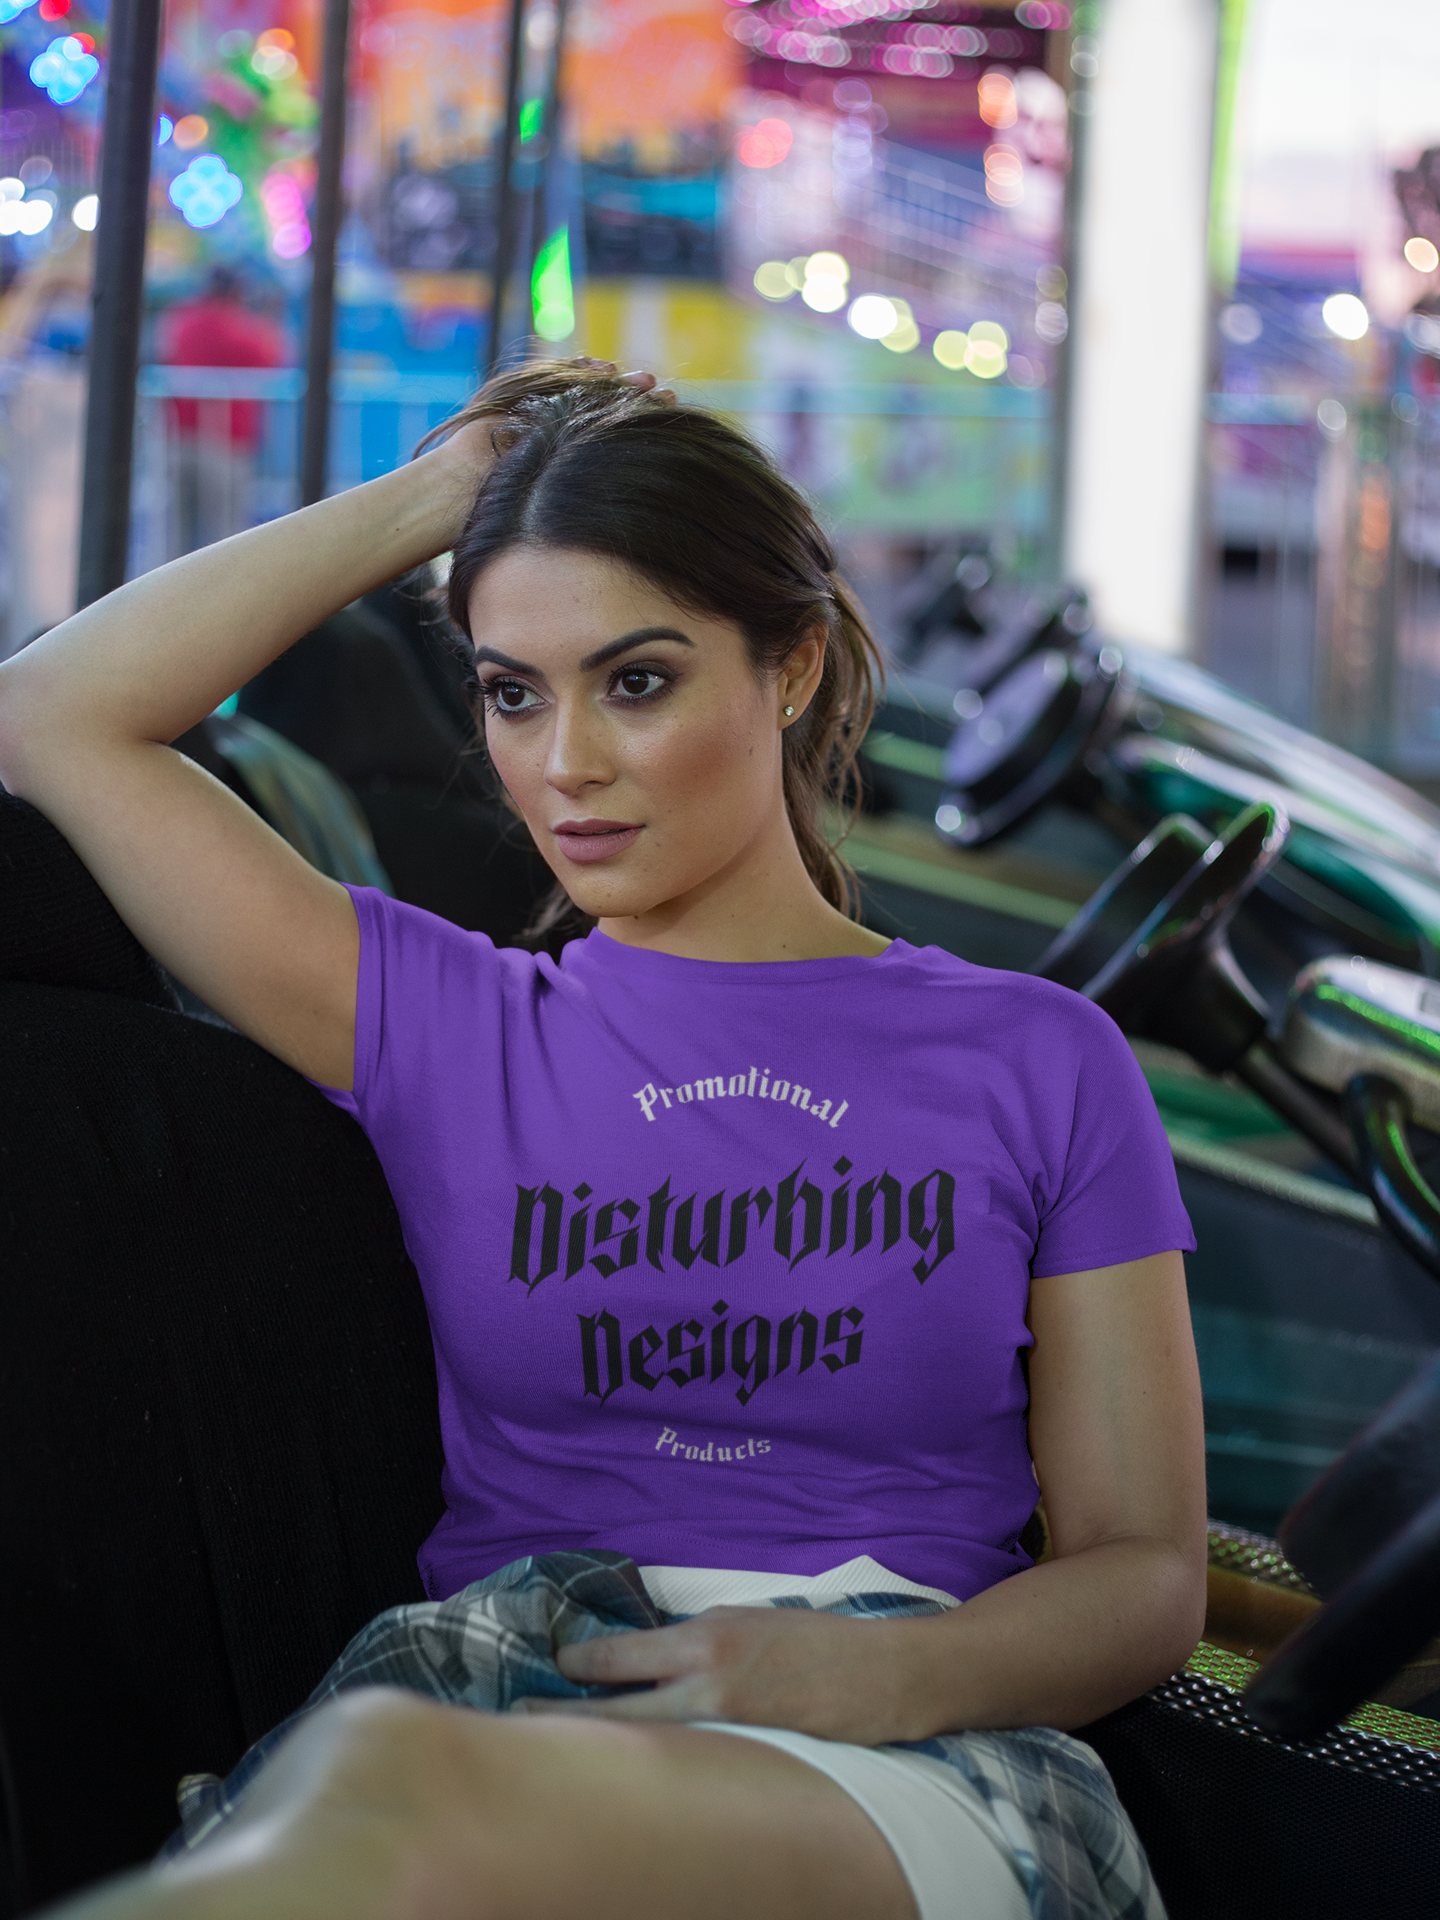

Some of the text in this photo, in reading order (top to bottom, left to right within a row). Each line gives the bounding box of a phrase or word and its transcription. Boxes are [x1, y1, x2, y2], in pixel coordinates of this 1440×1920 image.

[632, 1066, 849, 1128] Promotional
[507, 1155, 956, 1299] Disturbing
[576, 1299, 865, 1408] Designs
[655, 1426, 772, 1462] Products
